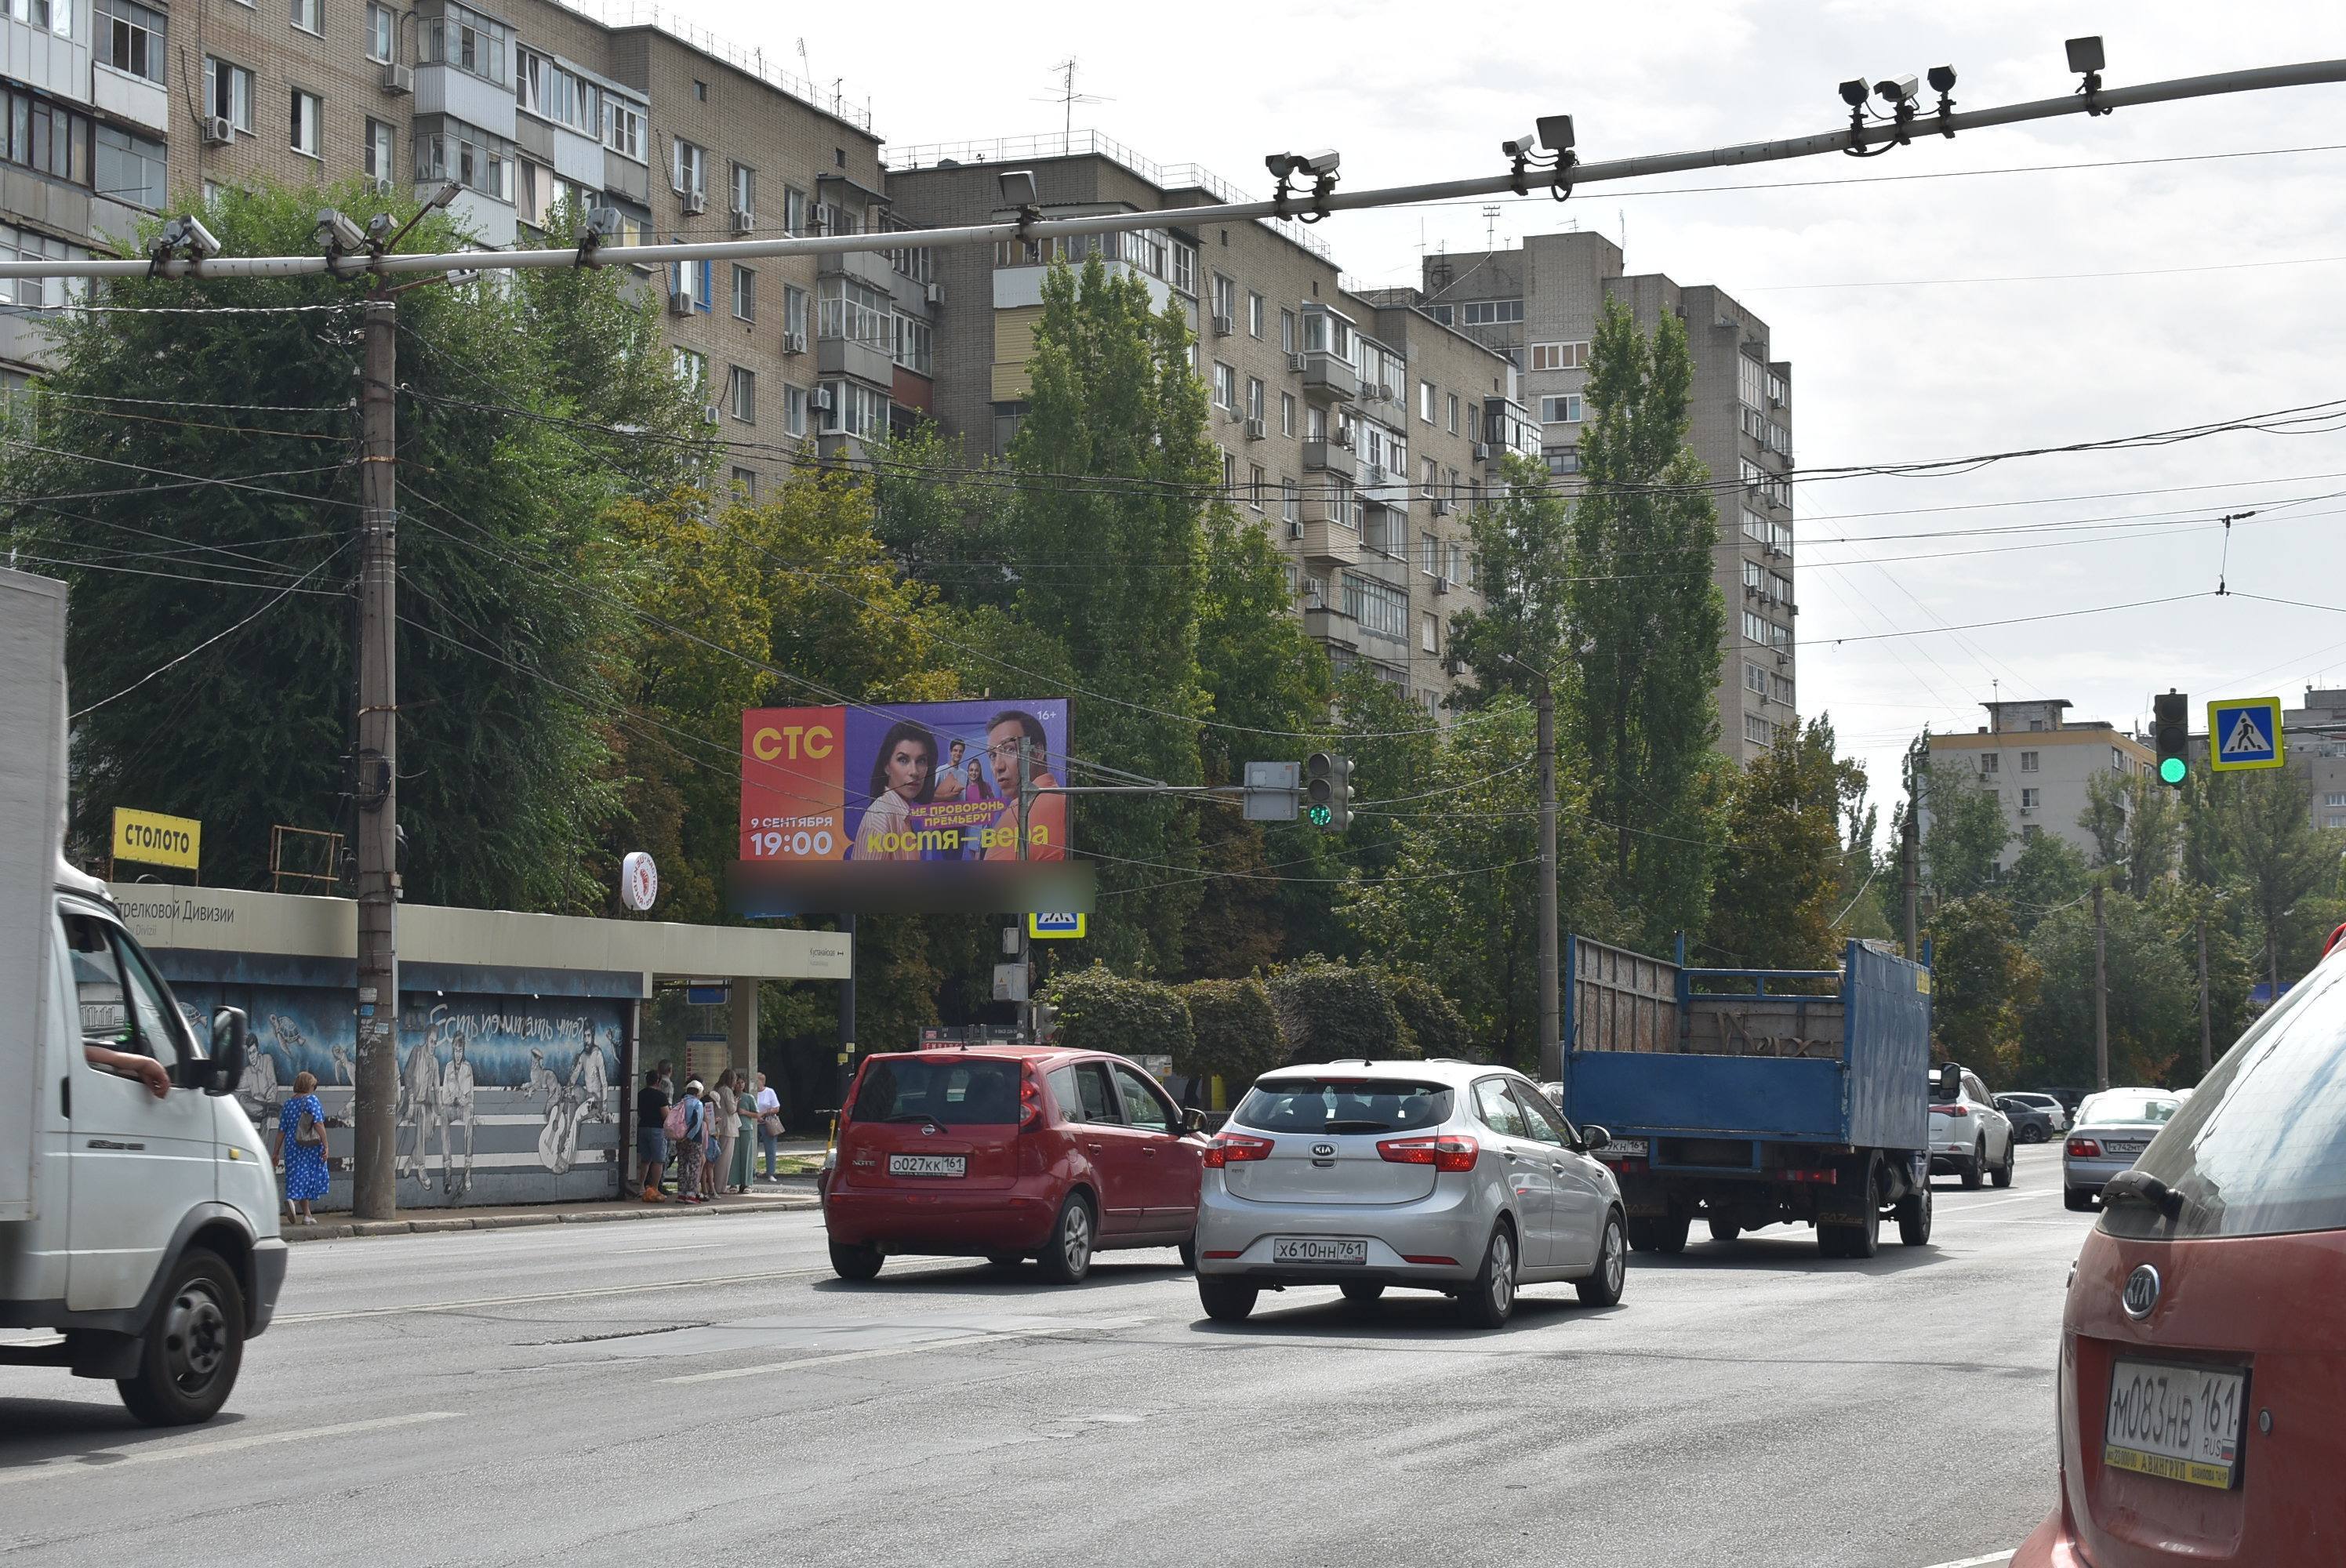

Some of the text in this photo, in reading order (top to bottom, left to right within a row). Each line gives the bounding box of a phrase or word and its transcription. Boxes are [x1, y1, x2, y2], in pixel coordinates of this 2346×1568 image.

[1037, 710, 1057, 720] 16+
[752, 725, 833, 761] СТС
[930, 801, 1004, 815] ПРОВОРОНЬ
[750, 816, 833, 829] 9 СЕНТЯБРЯ
[924, 812, 991, 827] ПРЕМЬЕРУ!
[125, 823, 190, 854] СТОЛОТО
[750, 830, 833, 856] 19:00
[181, 899, 235, 924] Дивизии
[893, 1157, 962, 1171] О027КК 161
[1279, 1241, 1361, 1258] Х610НН 761
[2126, 1276, 2152, 1306] KIA
[2112, 1373, 2236, 1449] М083НВ 161
[2203, 1437, 2221, 1457] RUS
[2141, 1454, 2186, 1481] АВИНГРУП
